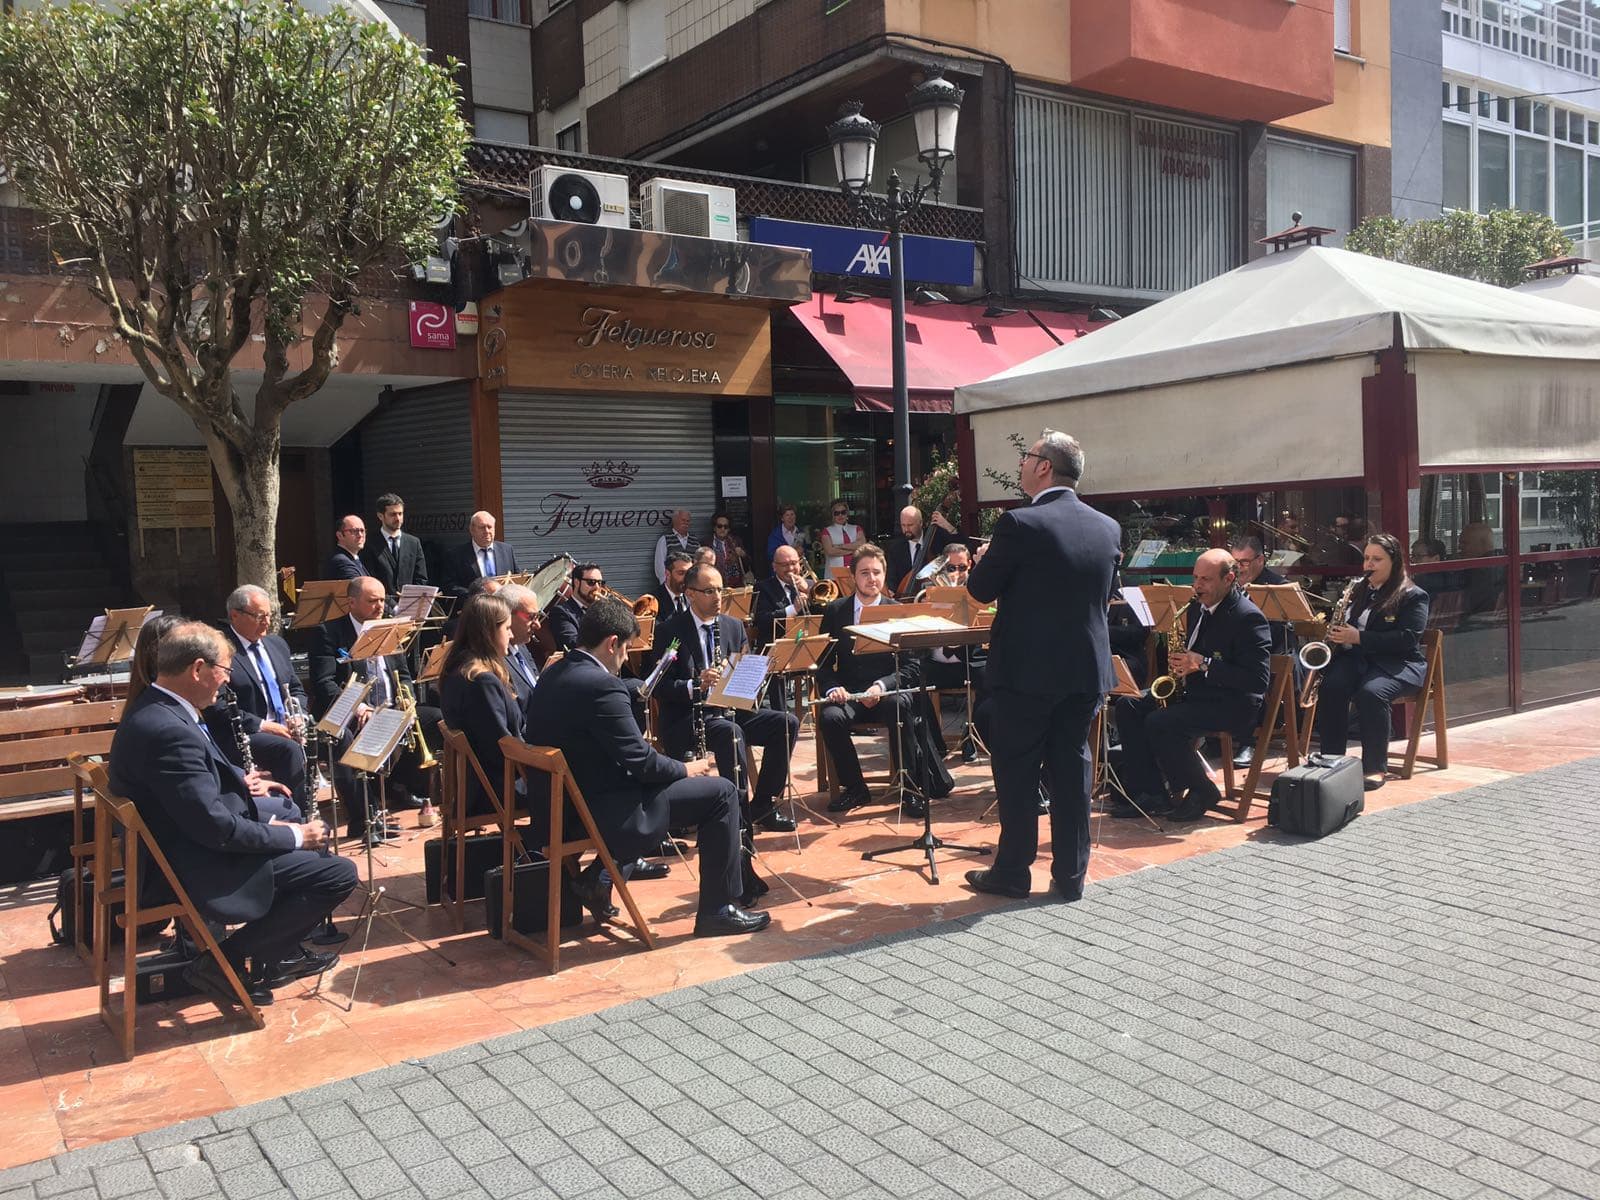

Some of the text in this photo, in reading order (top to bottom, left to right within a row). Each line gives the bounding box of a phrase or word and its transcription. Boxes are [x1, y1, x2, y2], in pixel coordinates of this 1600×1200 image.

[1162, 157, 1210, 181] ABOGADO
[845, 243, 892, 276] AXA
[427, 332, 450, 340] sama
[577, 306, 718, 351] Felgueroso
[532, 492, 673, 537] Felgueros
